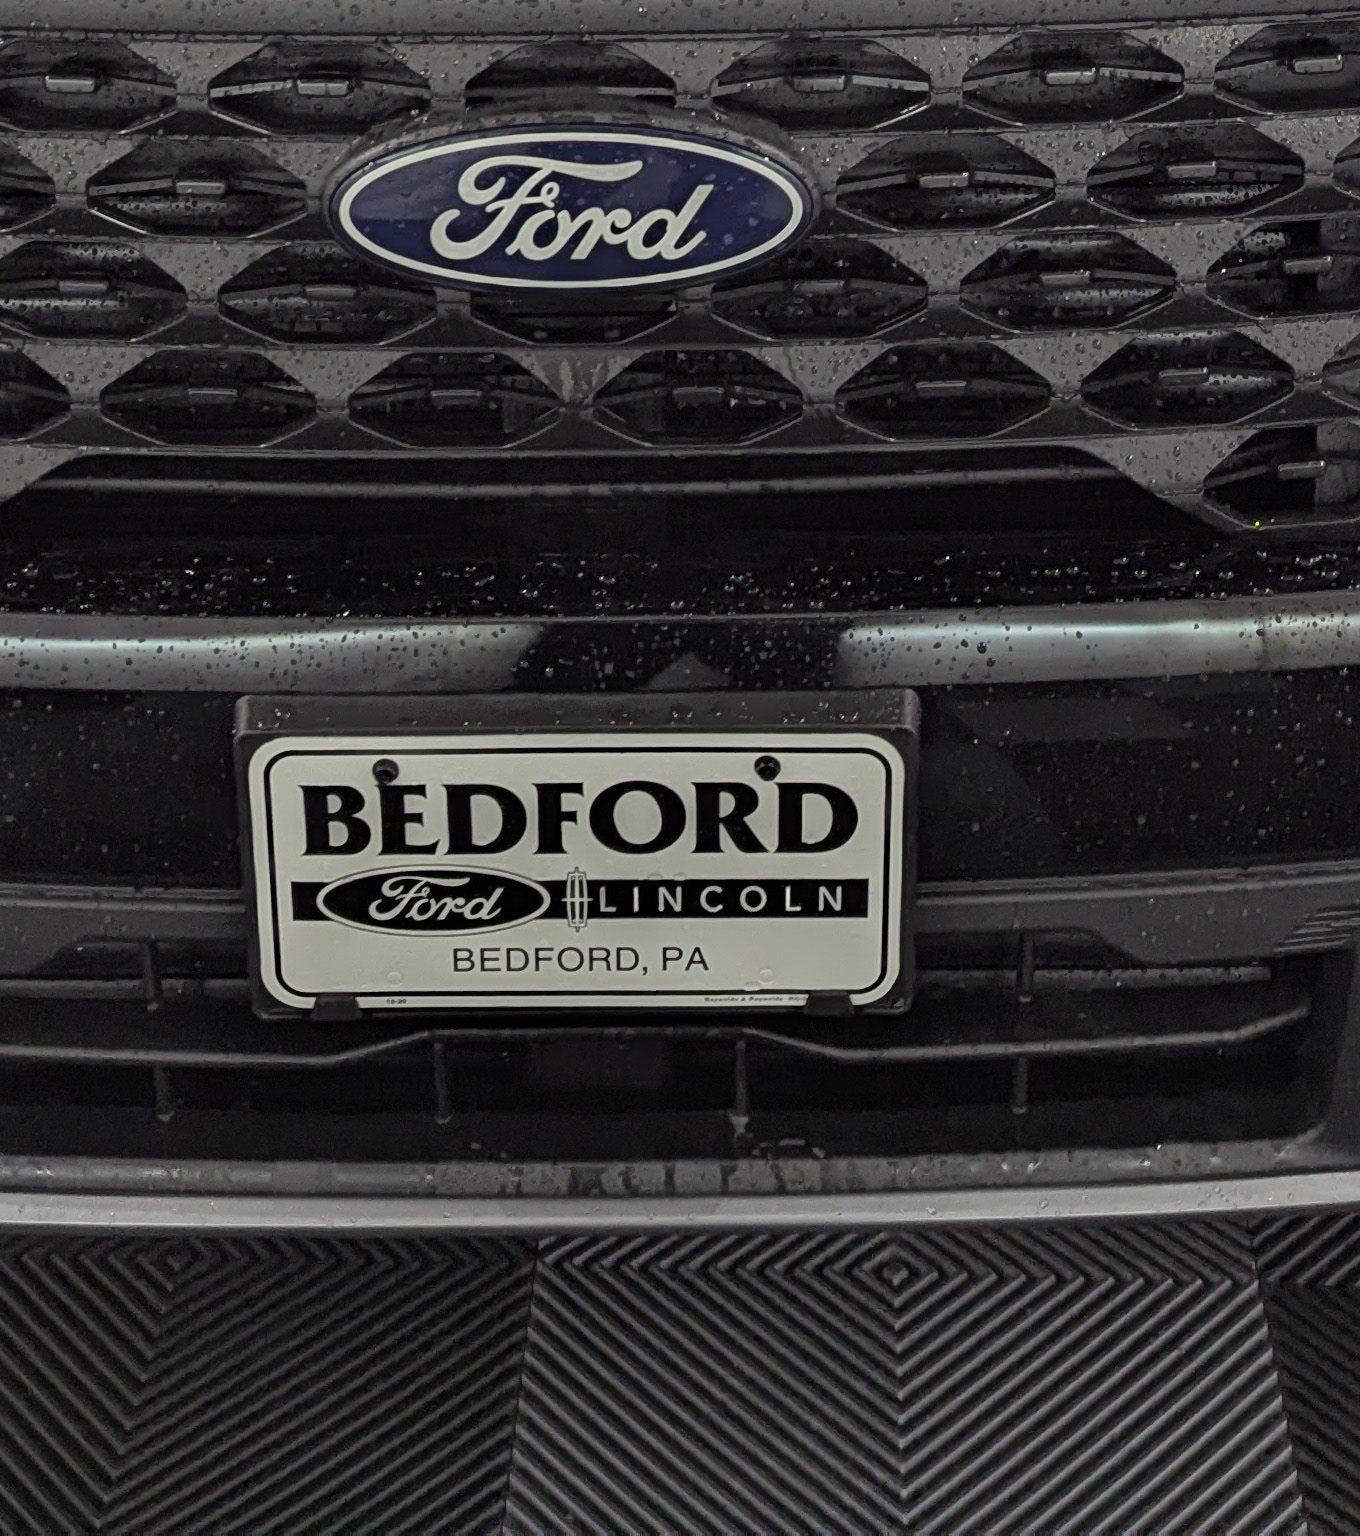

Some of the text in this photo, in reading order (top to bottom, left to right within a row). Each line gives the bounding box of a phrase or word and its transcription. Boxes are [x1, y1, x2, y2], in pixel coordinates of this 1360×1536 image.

[430, 154, 715, 262] Ford
[299, 779, 860, 857] BEDFORD
[369, 876, 843, 923] Ford LINCOLN
[452, 946, 710, 976] BEDFORD, PA
